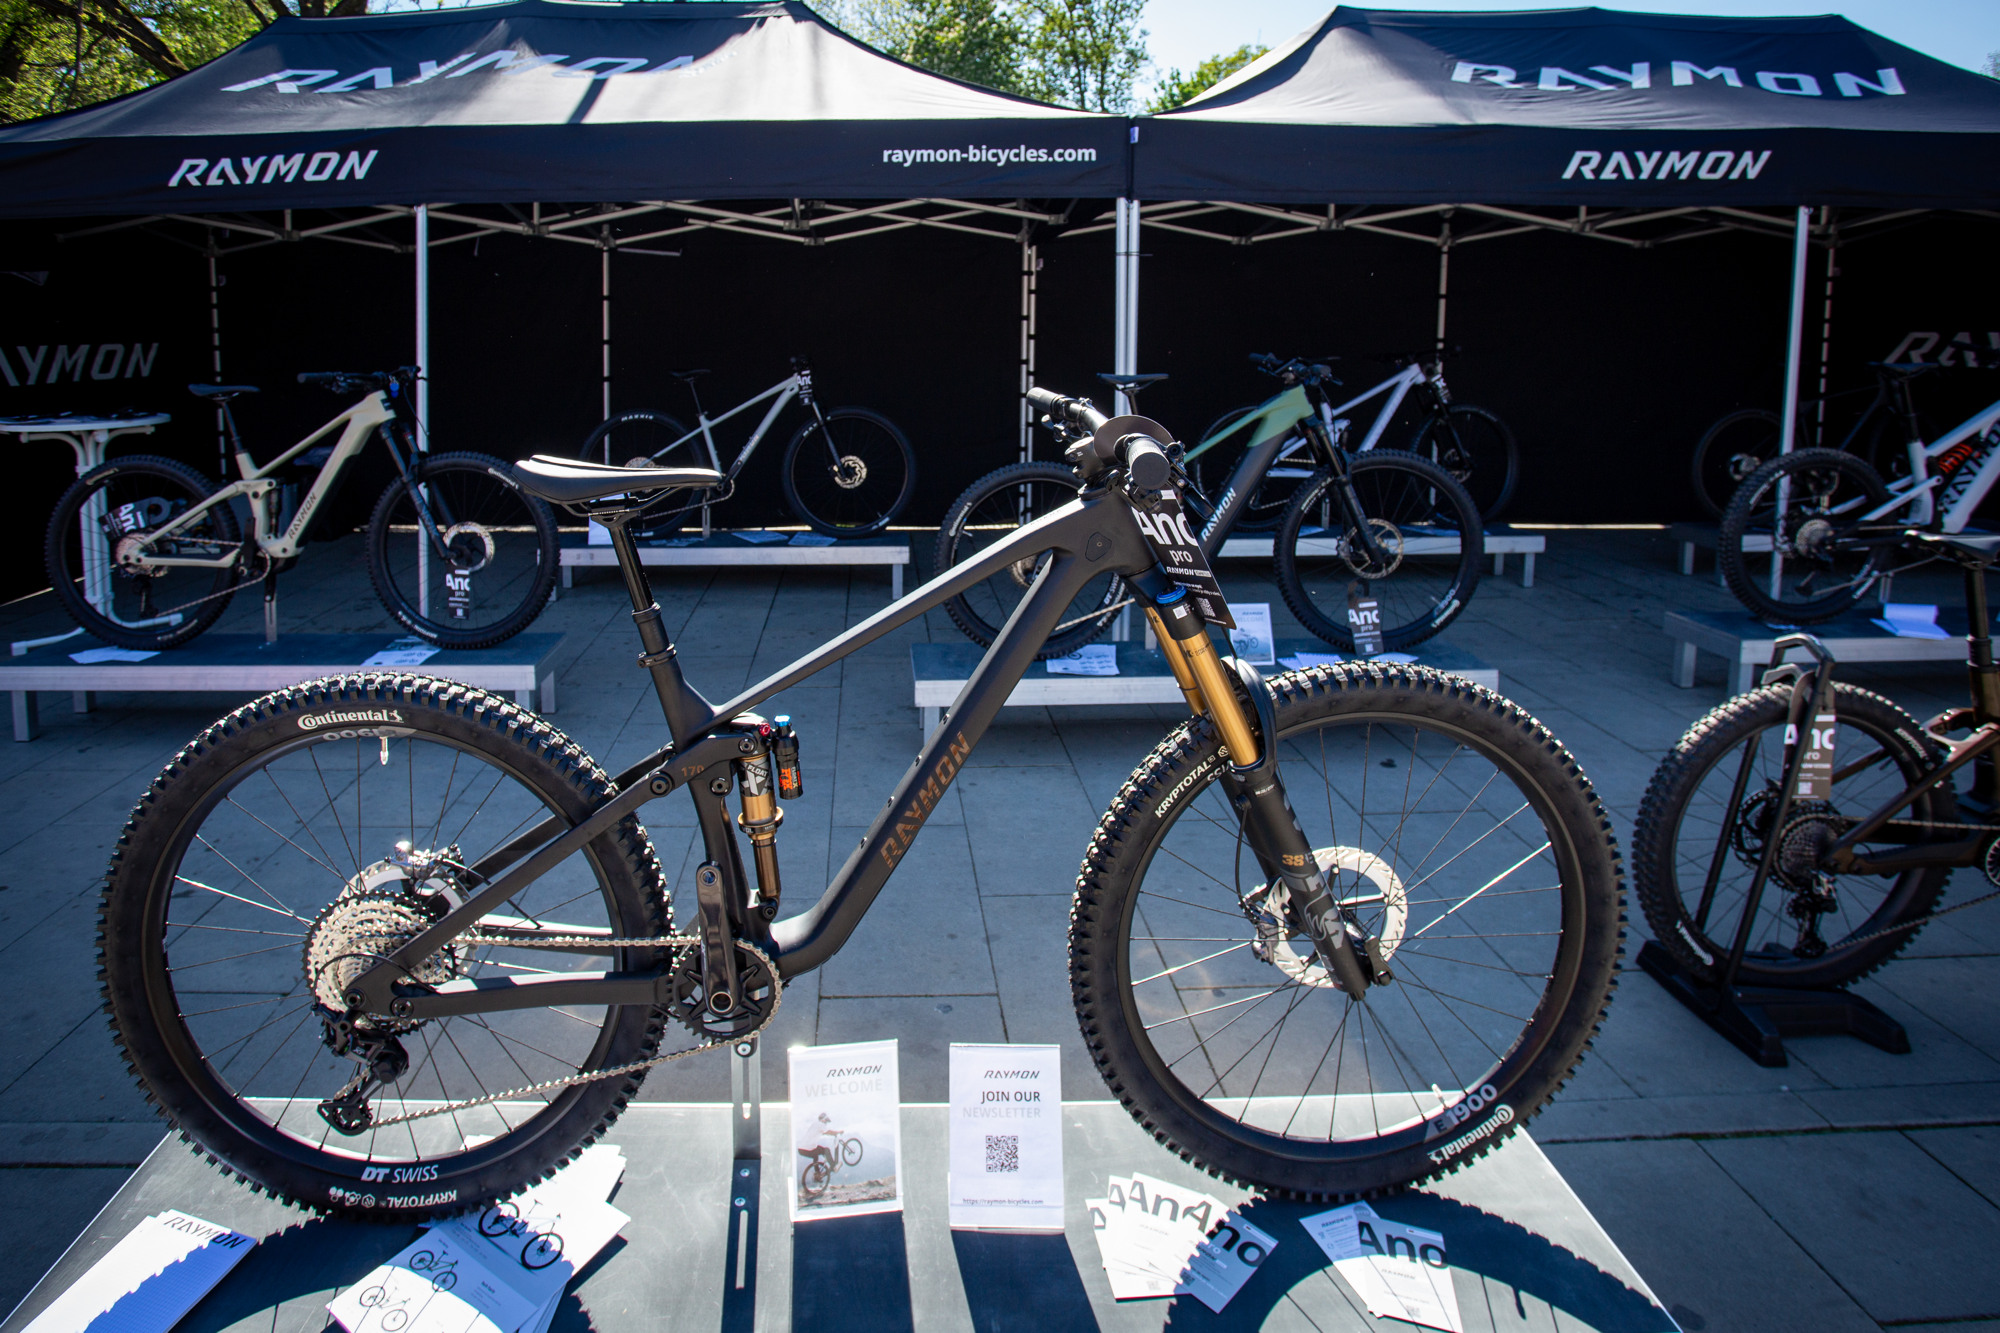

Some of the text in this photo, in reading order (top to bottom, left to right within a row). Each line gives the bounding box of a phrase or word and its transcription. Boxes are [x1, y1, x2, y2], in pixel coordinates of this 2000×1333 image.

[1451, 61, 1906, 96] RAYMON
[883, 145, 1096, 167] raymon-bicycles.com
[1562, 150, 1772, 180] RAYMON
[168, 150, 378, 187] RAYMON
[288, 492, 317, 540] RAYMON
[1201, 487, 1236, 541] RAYMON
[1169, 550, 1193, 565] pro
[1166, 566, 1194, 576] RAYMON
[298, 709, 389, 730] Continental
[681, 765, 704, 777] 170
[747, 764, 768, 777] FLOAT
[880, 731, 971, 868] RAYMON
[1154, 761, 1211, 818] KRYPTOTAL
[1282, 854, 1305, 866] 38
[827, 1065, 882, 1078] RAYMON
[984, 1070, 1040, 1079] RAYMON
[805, 1078, 883, 1098] WELCOME
[981, 1091, 1041, 1104] JOIN OUR
[963, 1107, 1041, 1118] NEWSLETTER
[1446, 1083, 1498, 1125] 1900
[1441, 1104, 1515, 1160] Continental
[361, 1165, 439, 1183] DT SWISS
[387, 1190, 457, 1208] KRYPTOTAL
[163, 1217, 247, 1249] RAYMON
[1358, 1221, 1449, 1270] Ano
